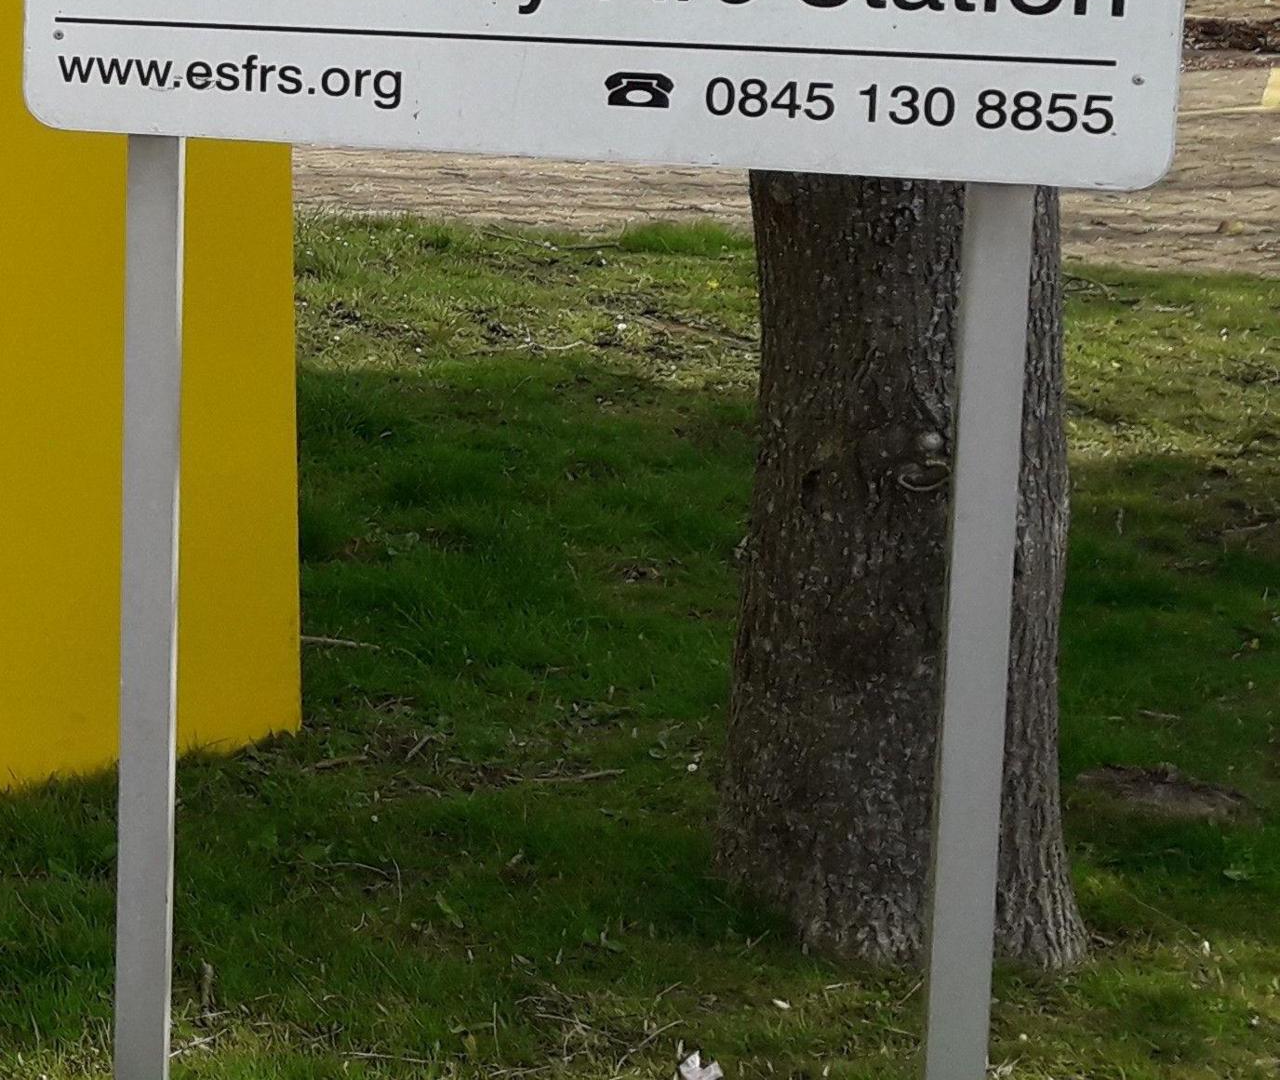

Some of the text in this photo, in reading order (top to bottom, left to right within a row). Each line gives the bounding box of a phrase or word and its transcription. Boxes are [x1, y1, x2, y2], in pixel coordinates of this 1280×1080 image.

[58, 54, 1114, 135] www.esfrs.org 0845 130 8855
